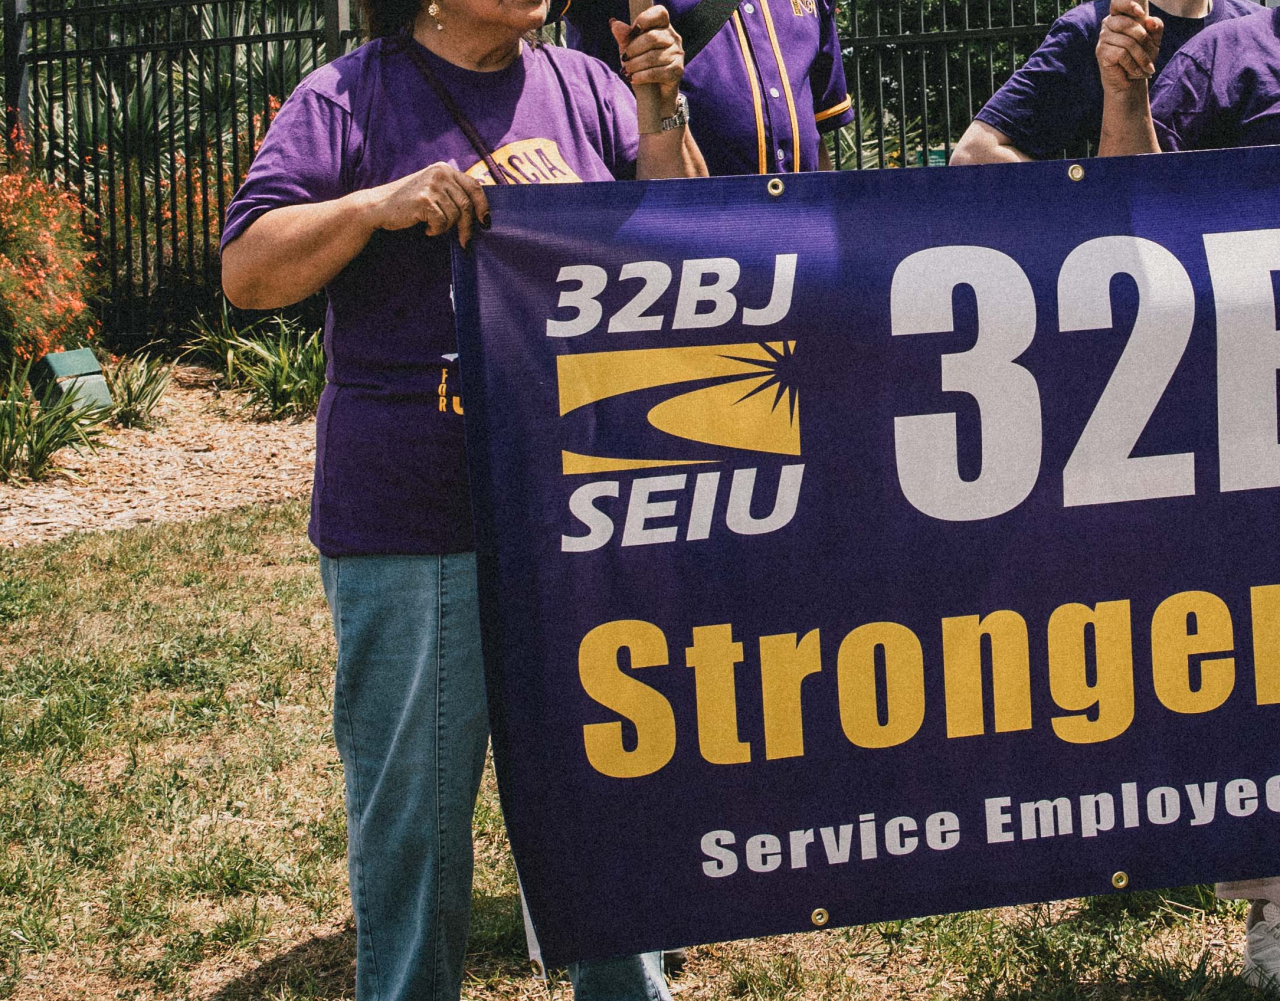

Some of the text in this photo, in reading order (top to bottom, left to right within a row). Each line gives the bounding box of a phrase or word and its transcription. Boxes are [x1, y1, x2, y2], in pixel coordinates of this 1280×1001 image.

[545, 253, 798, 339] 32BJ
[560, 463, 806, 553] SEIU
[700, 806, 960, 878] Service
